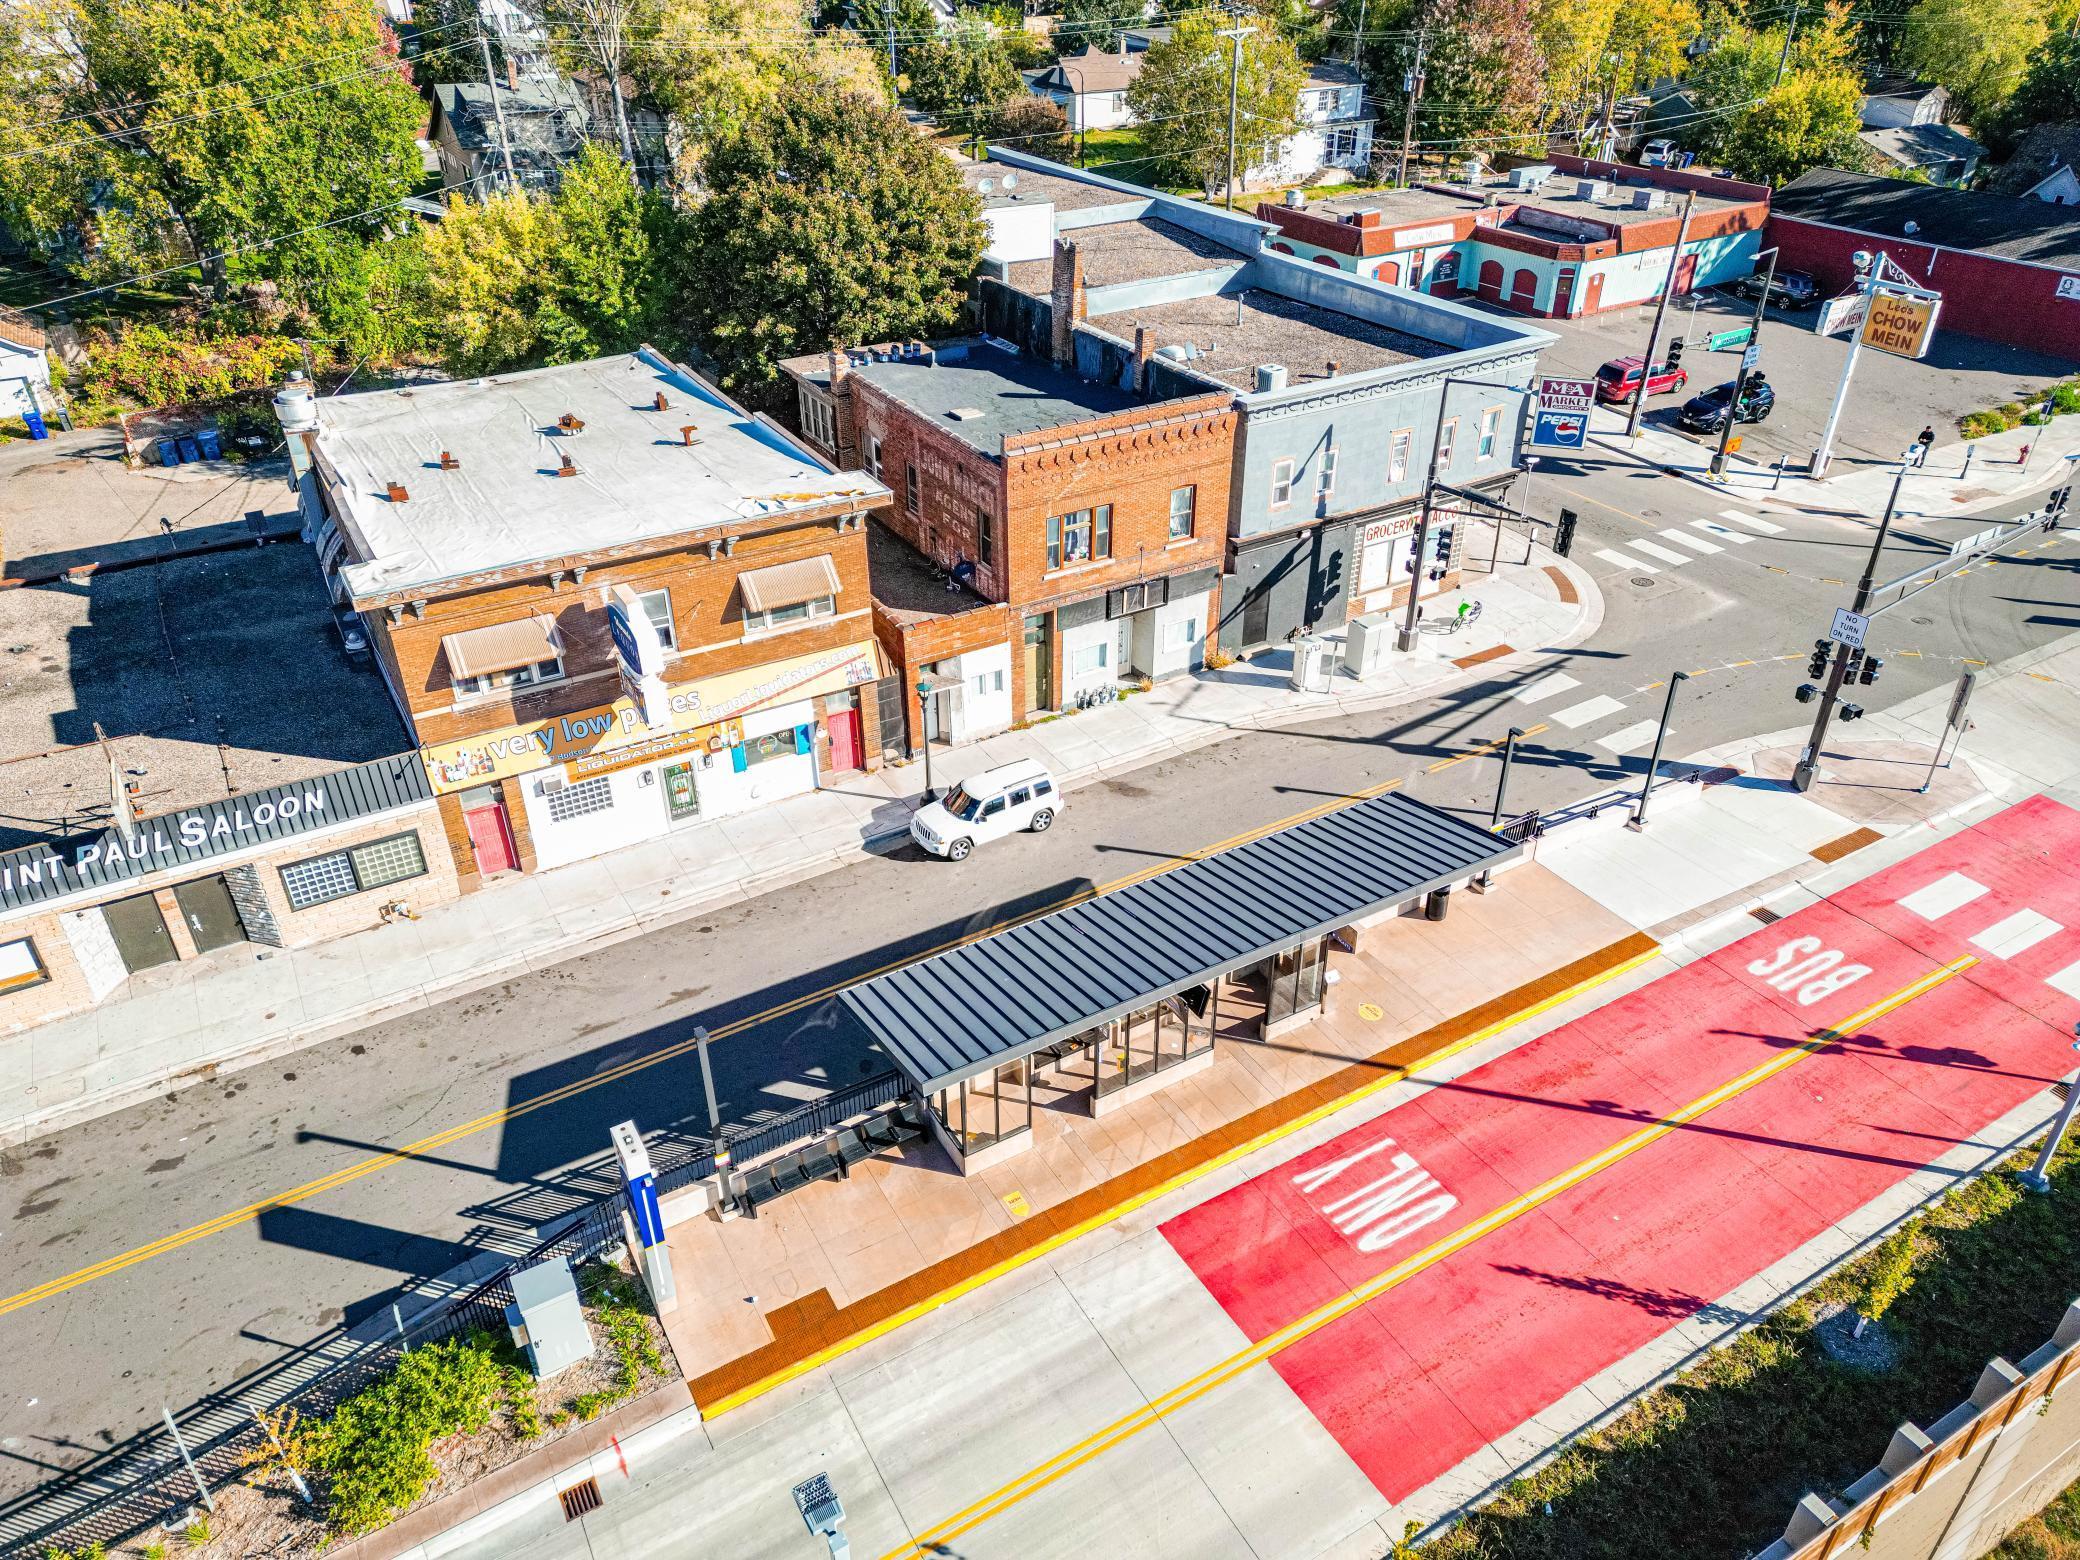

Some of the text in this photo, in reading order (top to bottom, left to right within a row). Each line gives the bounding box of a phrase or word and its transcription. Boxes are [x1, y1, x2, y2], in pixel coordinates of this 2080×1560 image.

[1887, 300, 1914, 316] Leo's
[1846, 311, 1864, 326] MEIN
[1872, 311, 1923, 334] CHOW
[1871, 328, 1913, 350] MEIN
[1548, 382, 1586, 396] M&A
[1539, 395, 1591, 409] MARKET
[1541, 414, 1584, 427] PEPSI
[1366, 505, 1459, 541] GROCERY TACCO
[1845, 615, 1858, 624] NO
[1833, 629, 1860, 644] ON RED
[1840, 622, 1859, 635] TURN
[698, 645, 861, 722] LiquorLiquidators.com
[489, 727, 555, 759] very
[561, 712, 612, 742] low
[619, 690, 702, 735] pes
[615, 759, 639, 771] QUALITY
[0, 789, 324, 892] INT PAUL SALOON
[1746, 934, 1873, 1006] BUS
[1292, 1138, 1457, 1251] ONLY
